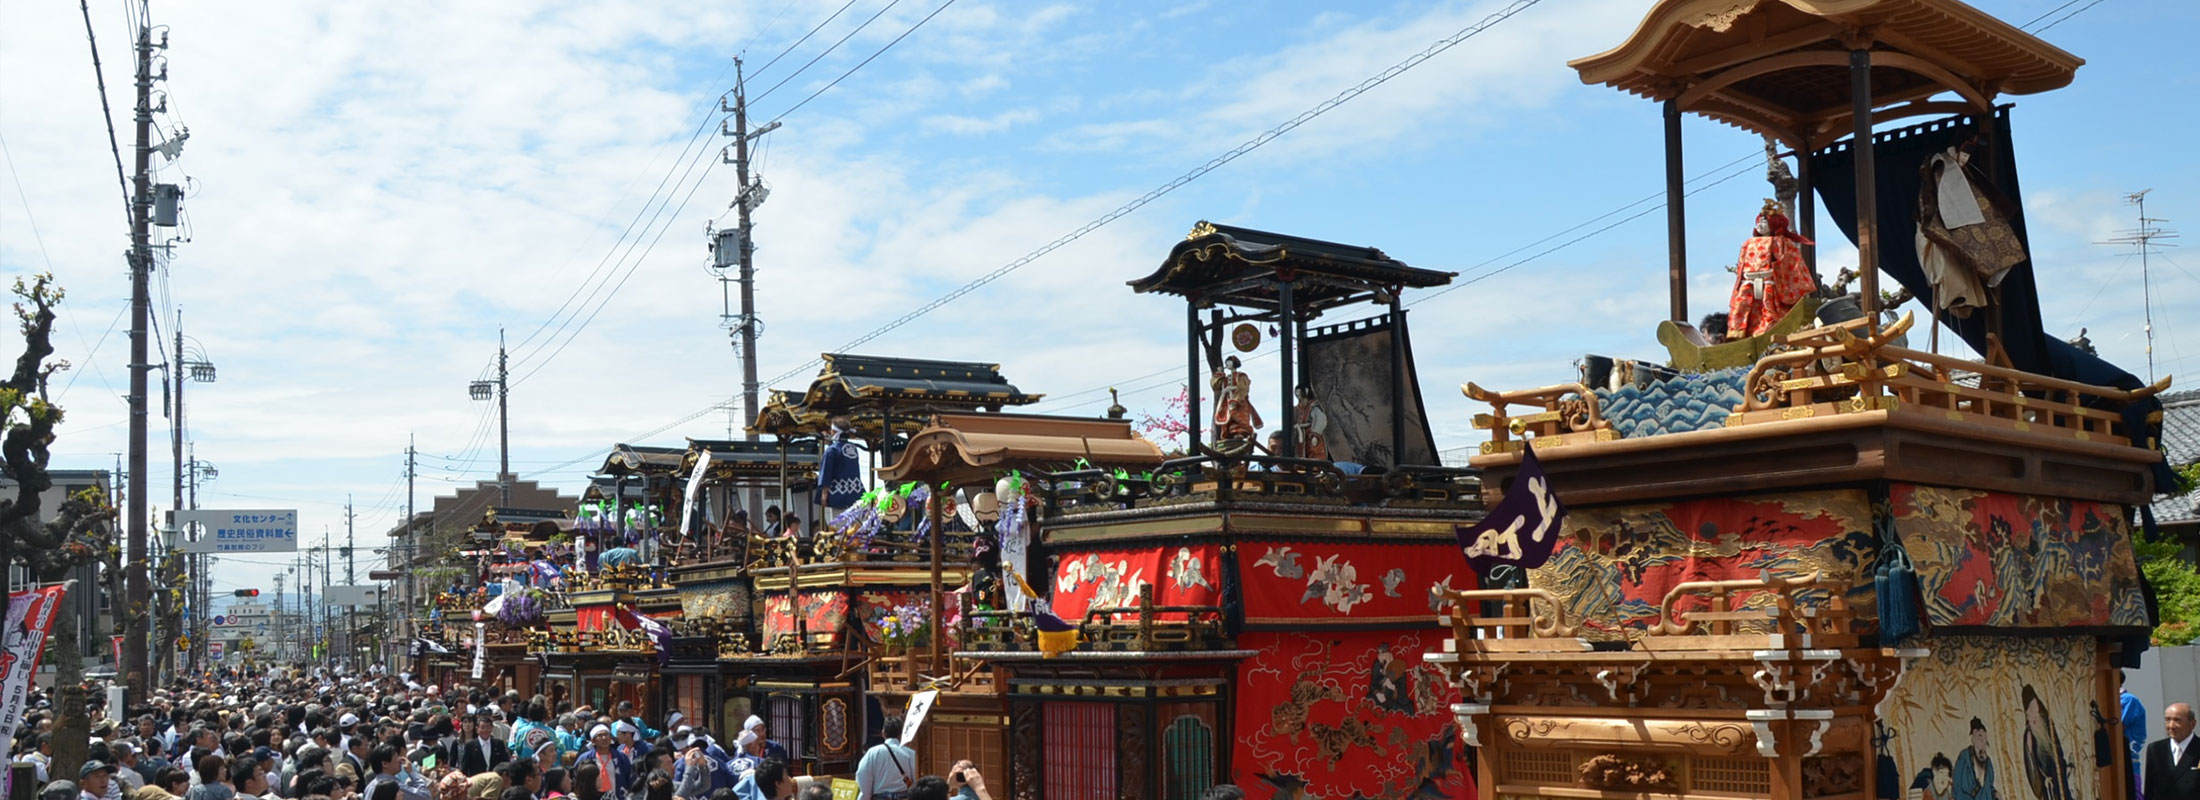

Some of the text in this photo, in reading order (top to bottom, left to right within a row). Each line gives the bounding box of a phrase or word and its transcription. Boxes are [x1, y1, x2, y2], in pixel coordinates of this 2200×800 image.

[233, 514, 285, 524] 文化センター
[217, 528, 284, 539] 歴史民俗資料館
